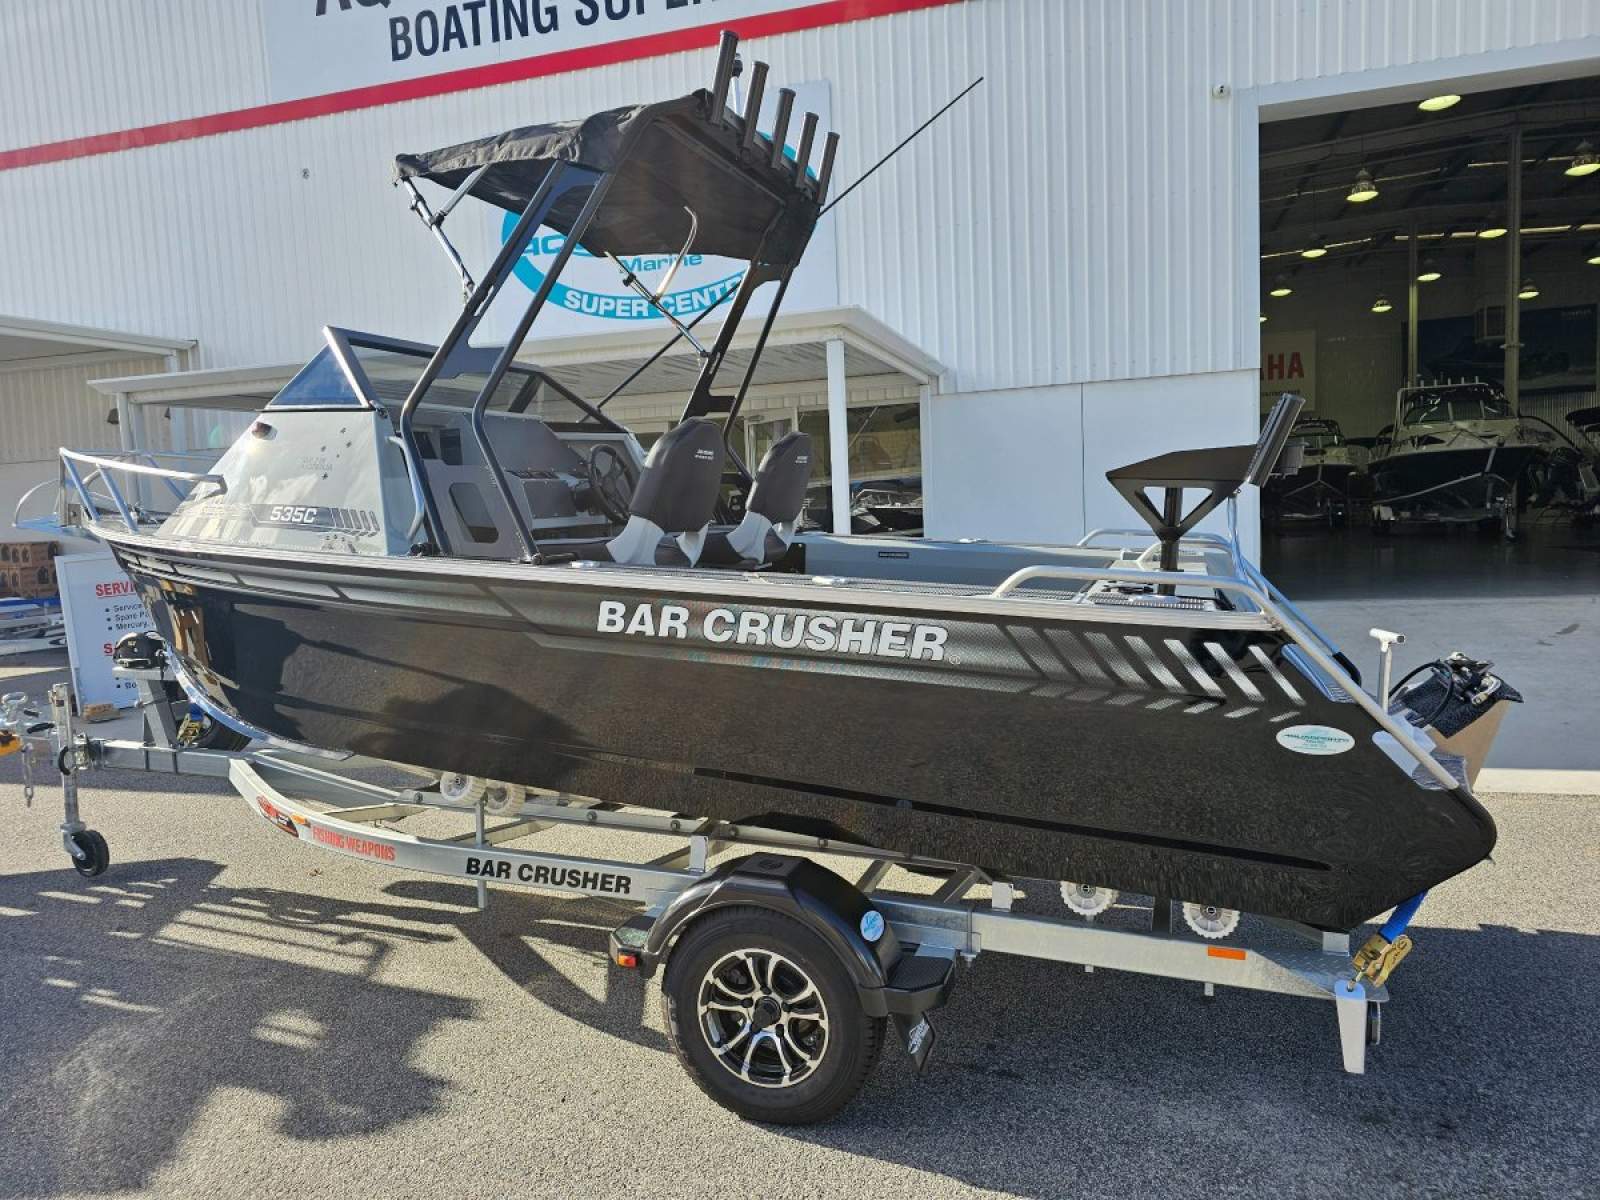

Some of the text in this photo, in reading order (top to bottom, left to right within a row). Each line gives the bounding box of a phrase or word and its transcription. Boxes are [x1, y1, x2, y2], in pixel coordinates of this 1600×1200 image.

[389, 0, 559, 62] BOATING
[563, 271, 744, 317] SUPER CENTR
[269, 505, 317, 524] 535C
[95, 580, 137, 597] SERVI
[597, 600, 949, 662] BAR CRUSHER
[312, 825, 396, 861] FISHING WEAPONS
[465, 856, 632, 895] BAR CRUSHER
